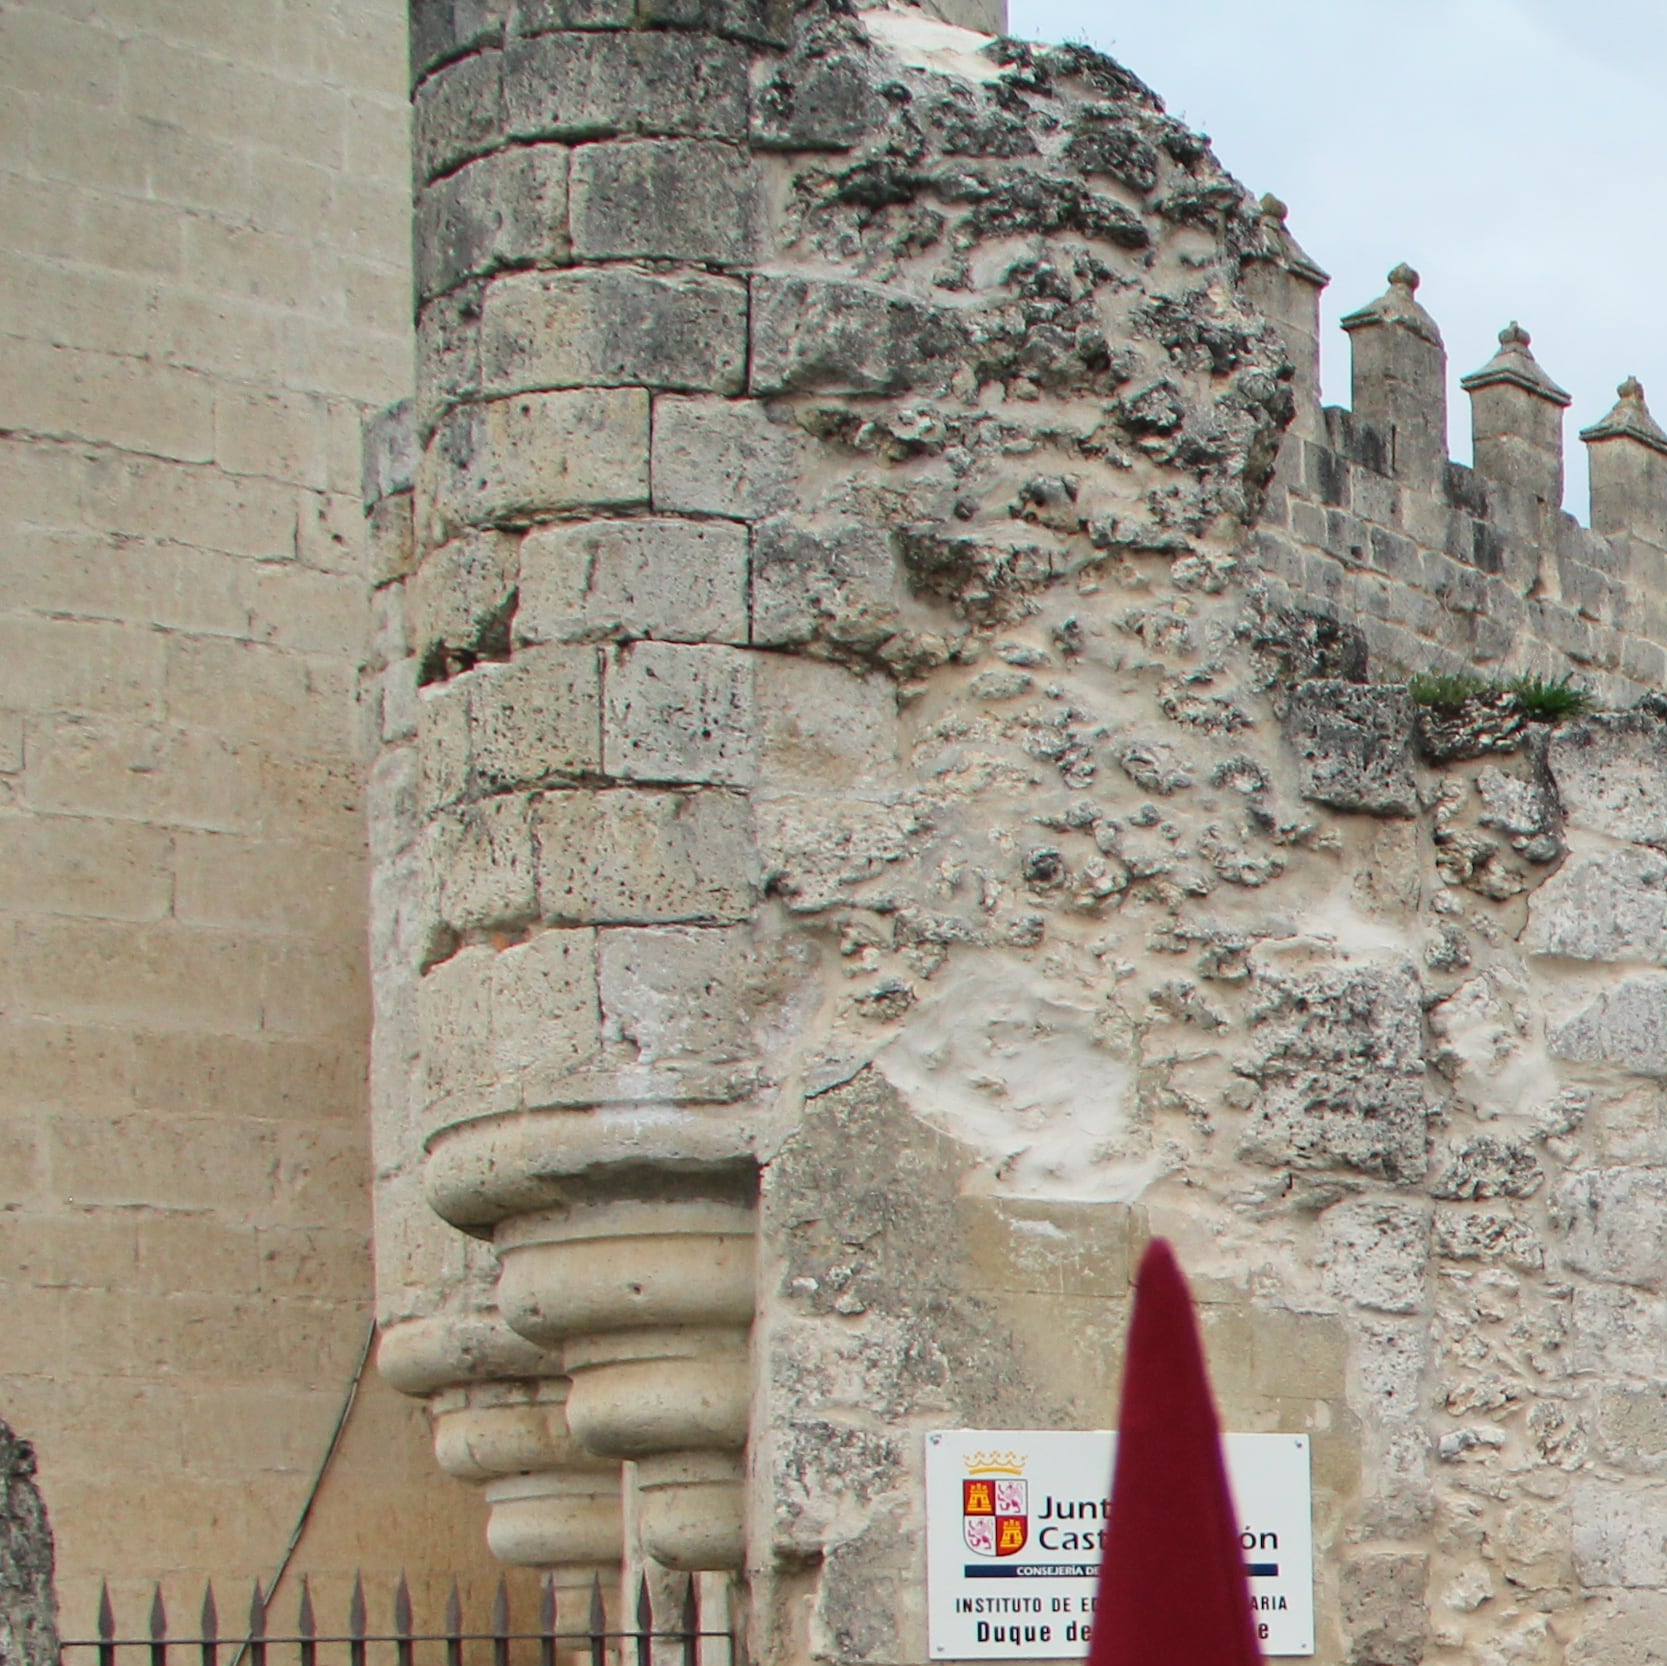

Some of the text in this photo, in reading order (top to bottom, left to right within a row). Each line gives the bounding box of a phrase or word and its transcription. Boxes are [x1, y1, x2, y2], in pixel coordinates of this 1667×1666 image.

[1038, 1495, 1111, 1519] Junt
[1039, 1525, 1278, 1550] Cast ón
[1016, 1565, 1084, 1576] CONSEJERÍA
[956, 1597, 1042, 1613] INSTITUTO
[1051, 1597, 1072, 1613] DE
[977, 1620, 1094, 1646] Duque de
